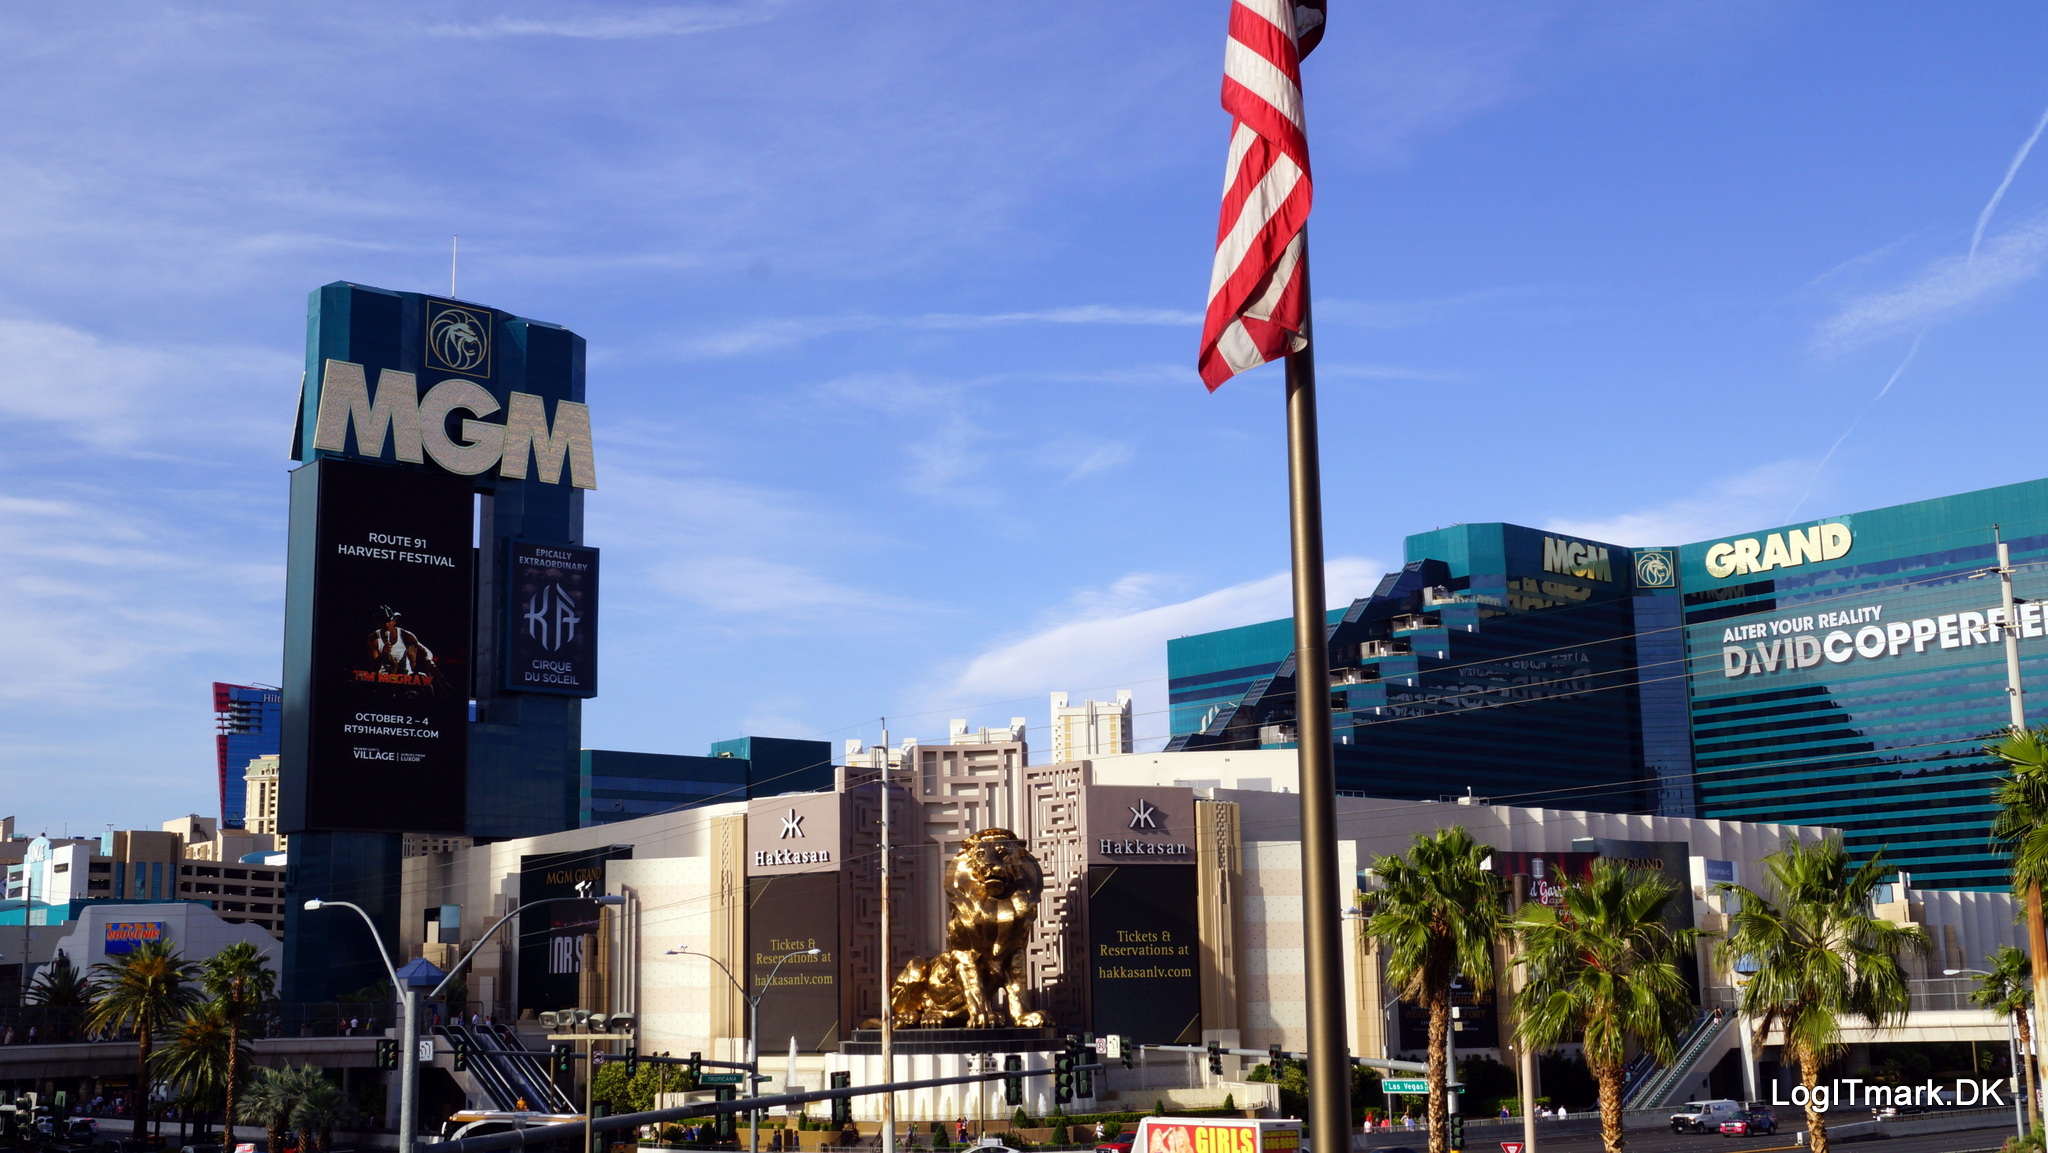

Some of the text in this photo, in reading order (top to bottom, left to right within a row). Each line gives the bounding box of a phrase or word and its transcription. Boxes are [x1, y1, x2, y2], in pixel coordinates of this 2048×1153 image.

[313, 358, 597, 490] MGM
[369, 533, 427, 549] ROUTE 91
[338, 544, 455, 567] HARVEST FESTIVAL
[536, 548, 572, 560] EPICALLY
[1705, 522, 1853, 579] GRAND
[519, 556, 588, 572] EXTRAORDINARY
[1543, 536, 1613, 583] MGM
[1723, 605, 1882, 643] ALTER YOUR REALITY
[532, 659, 572, 674] CIRQUE
[353, 670, 374, 682] TIM
[525, 672, 579, 686] DU SOLEIL
[355, 712, 404, 724] OCTOBER
[406, 716, 413, 725] 2
[422, 717, 429, 726] 4
[344, 724, 439, 738] RT91HARVEST.COM
[353, 750, 395, 761] VILLAGE
[1100, 839, 1187, 854] Hakkasan
[755, 849, 828, 866] Hakkasan
[1627, 857, 1664, 871] GRAND
[546, 867, 602, 884] MGM GRAND
[107, 930, 160, 941] SOUVENIR
[1117, 930, 1158, 942] Tickets
[771, 939, 804, 950] Tickets
[1100, 944, 1189, 956] Reservations at
[756, 951, 831, 965] Reservations at
[1099, 965, 1191, 979] hakkasanlv.com
[1404, 1083, 1424, 1091] Vegas
[1195, 1127, 1254, 1153] GIRLS
